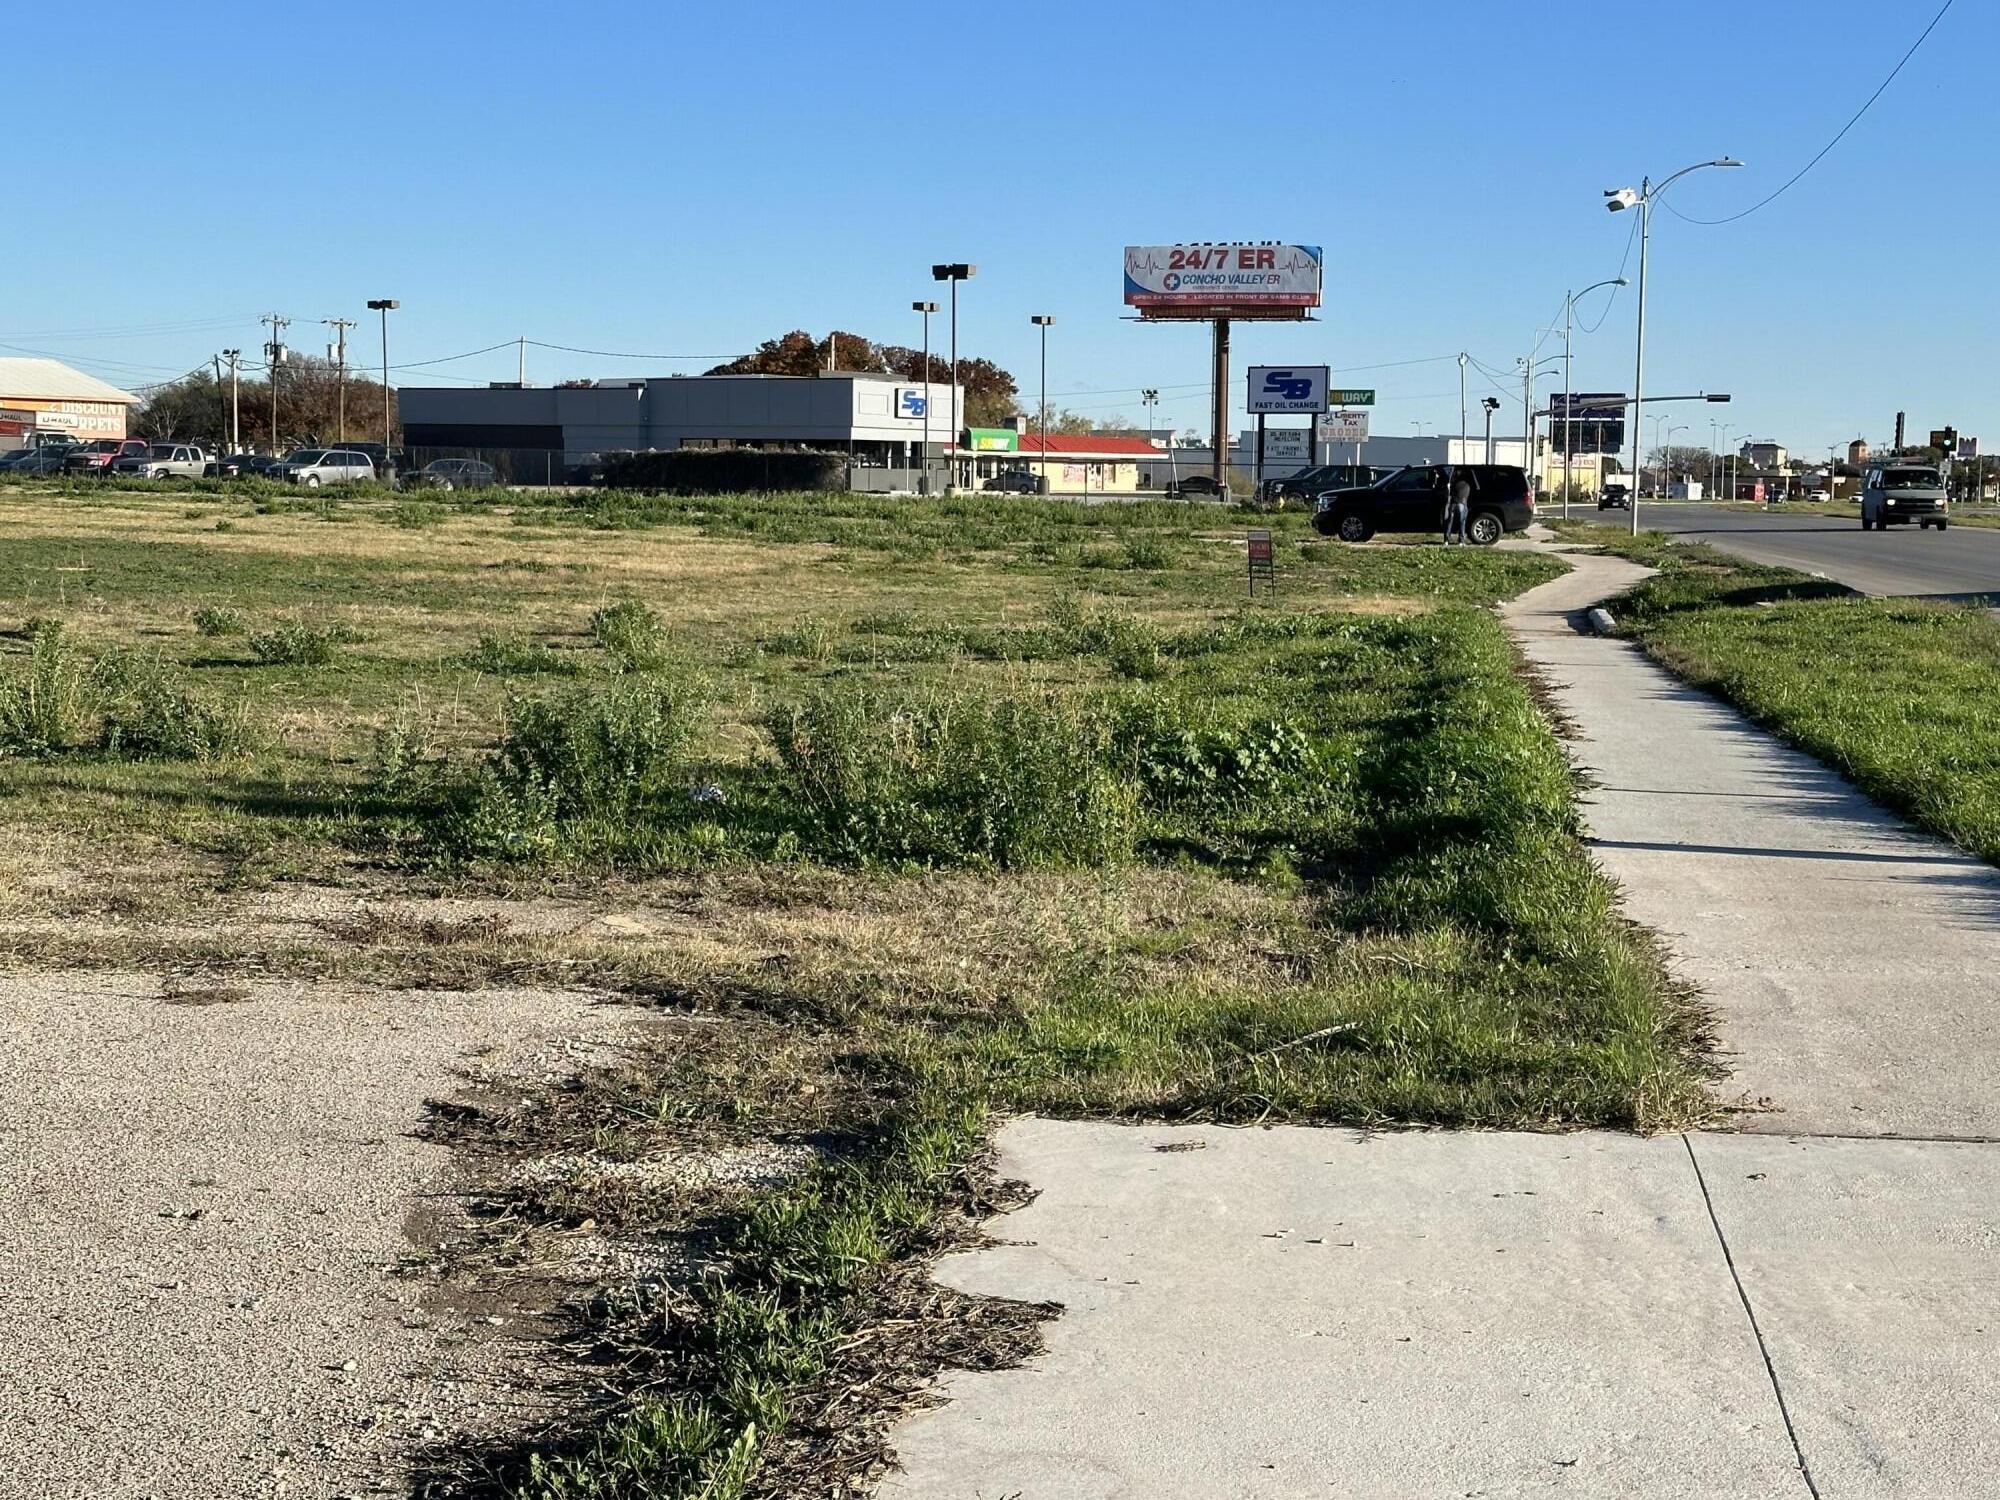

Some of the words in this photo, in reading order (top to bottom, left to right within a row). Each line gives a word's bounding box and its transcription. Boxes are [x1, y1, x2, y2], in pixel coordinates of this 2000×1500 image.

[1169, 249, 1229, 270] 24/7
[1238, 249, 1275, 270] ER
[1182, 274, 1226, 285] CONCHO
[1228, 274, 1265, 285] VALLEY
[1266, 274, 1281, 285] ER
[1263, 372, 1313, 400] SB
[902, 391, 926, 416] SB
[1255, 401, 1273, 409] FAST
[1274, 401, 1287, 409] OIL
[1289, 401, 1319, 409] CHANGE
